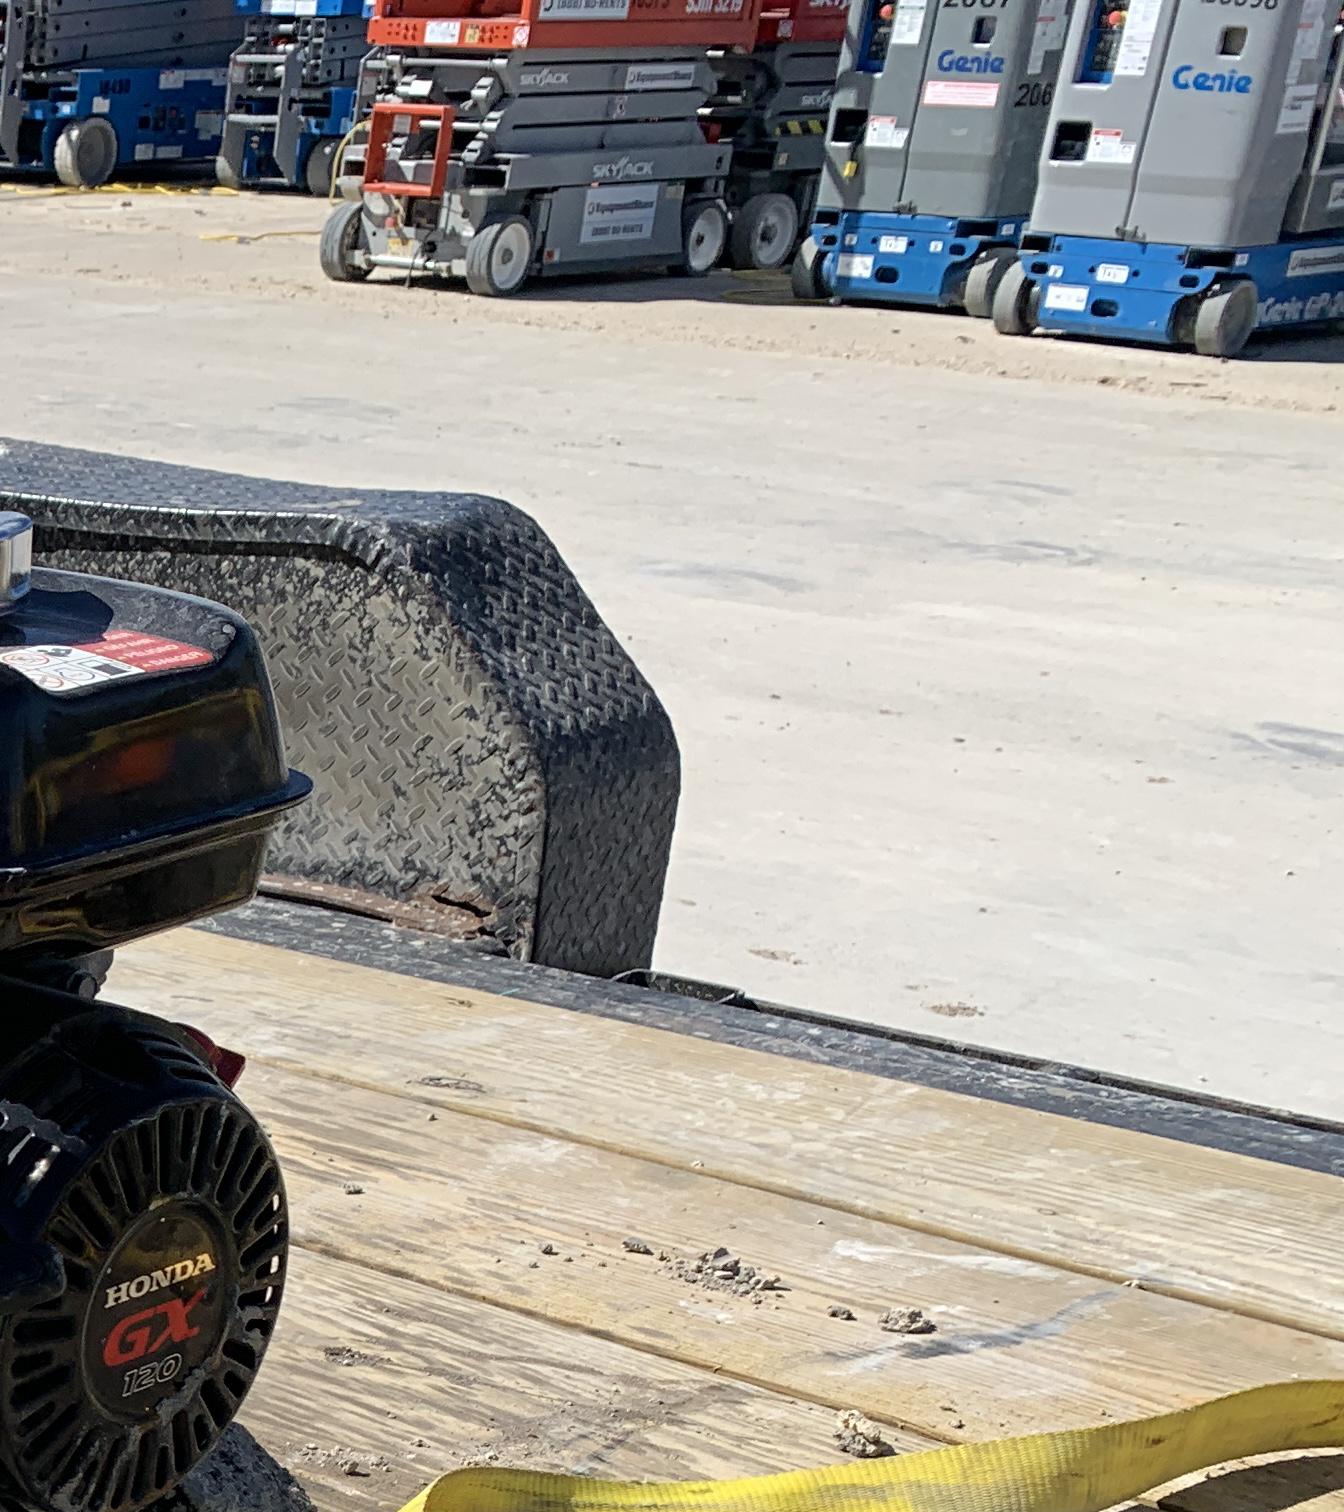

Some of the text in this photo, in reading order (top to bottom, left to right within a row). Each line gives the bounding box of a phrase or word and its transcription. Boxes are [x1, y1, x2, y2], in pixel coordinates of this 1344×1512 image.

[520, 67, 569, 87] SKYJACK
[937, 50, 1005, 74] Genie
[1172, 64, 1253, 94] Genie
[592, 156, 654, 179] SKYJACK
[104, 1253, 215, 1309] HONDA
[103, 1286, 209, 1367] GX
[122, 1353, 182, 1397] 120
